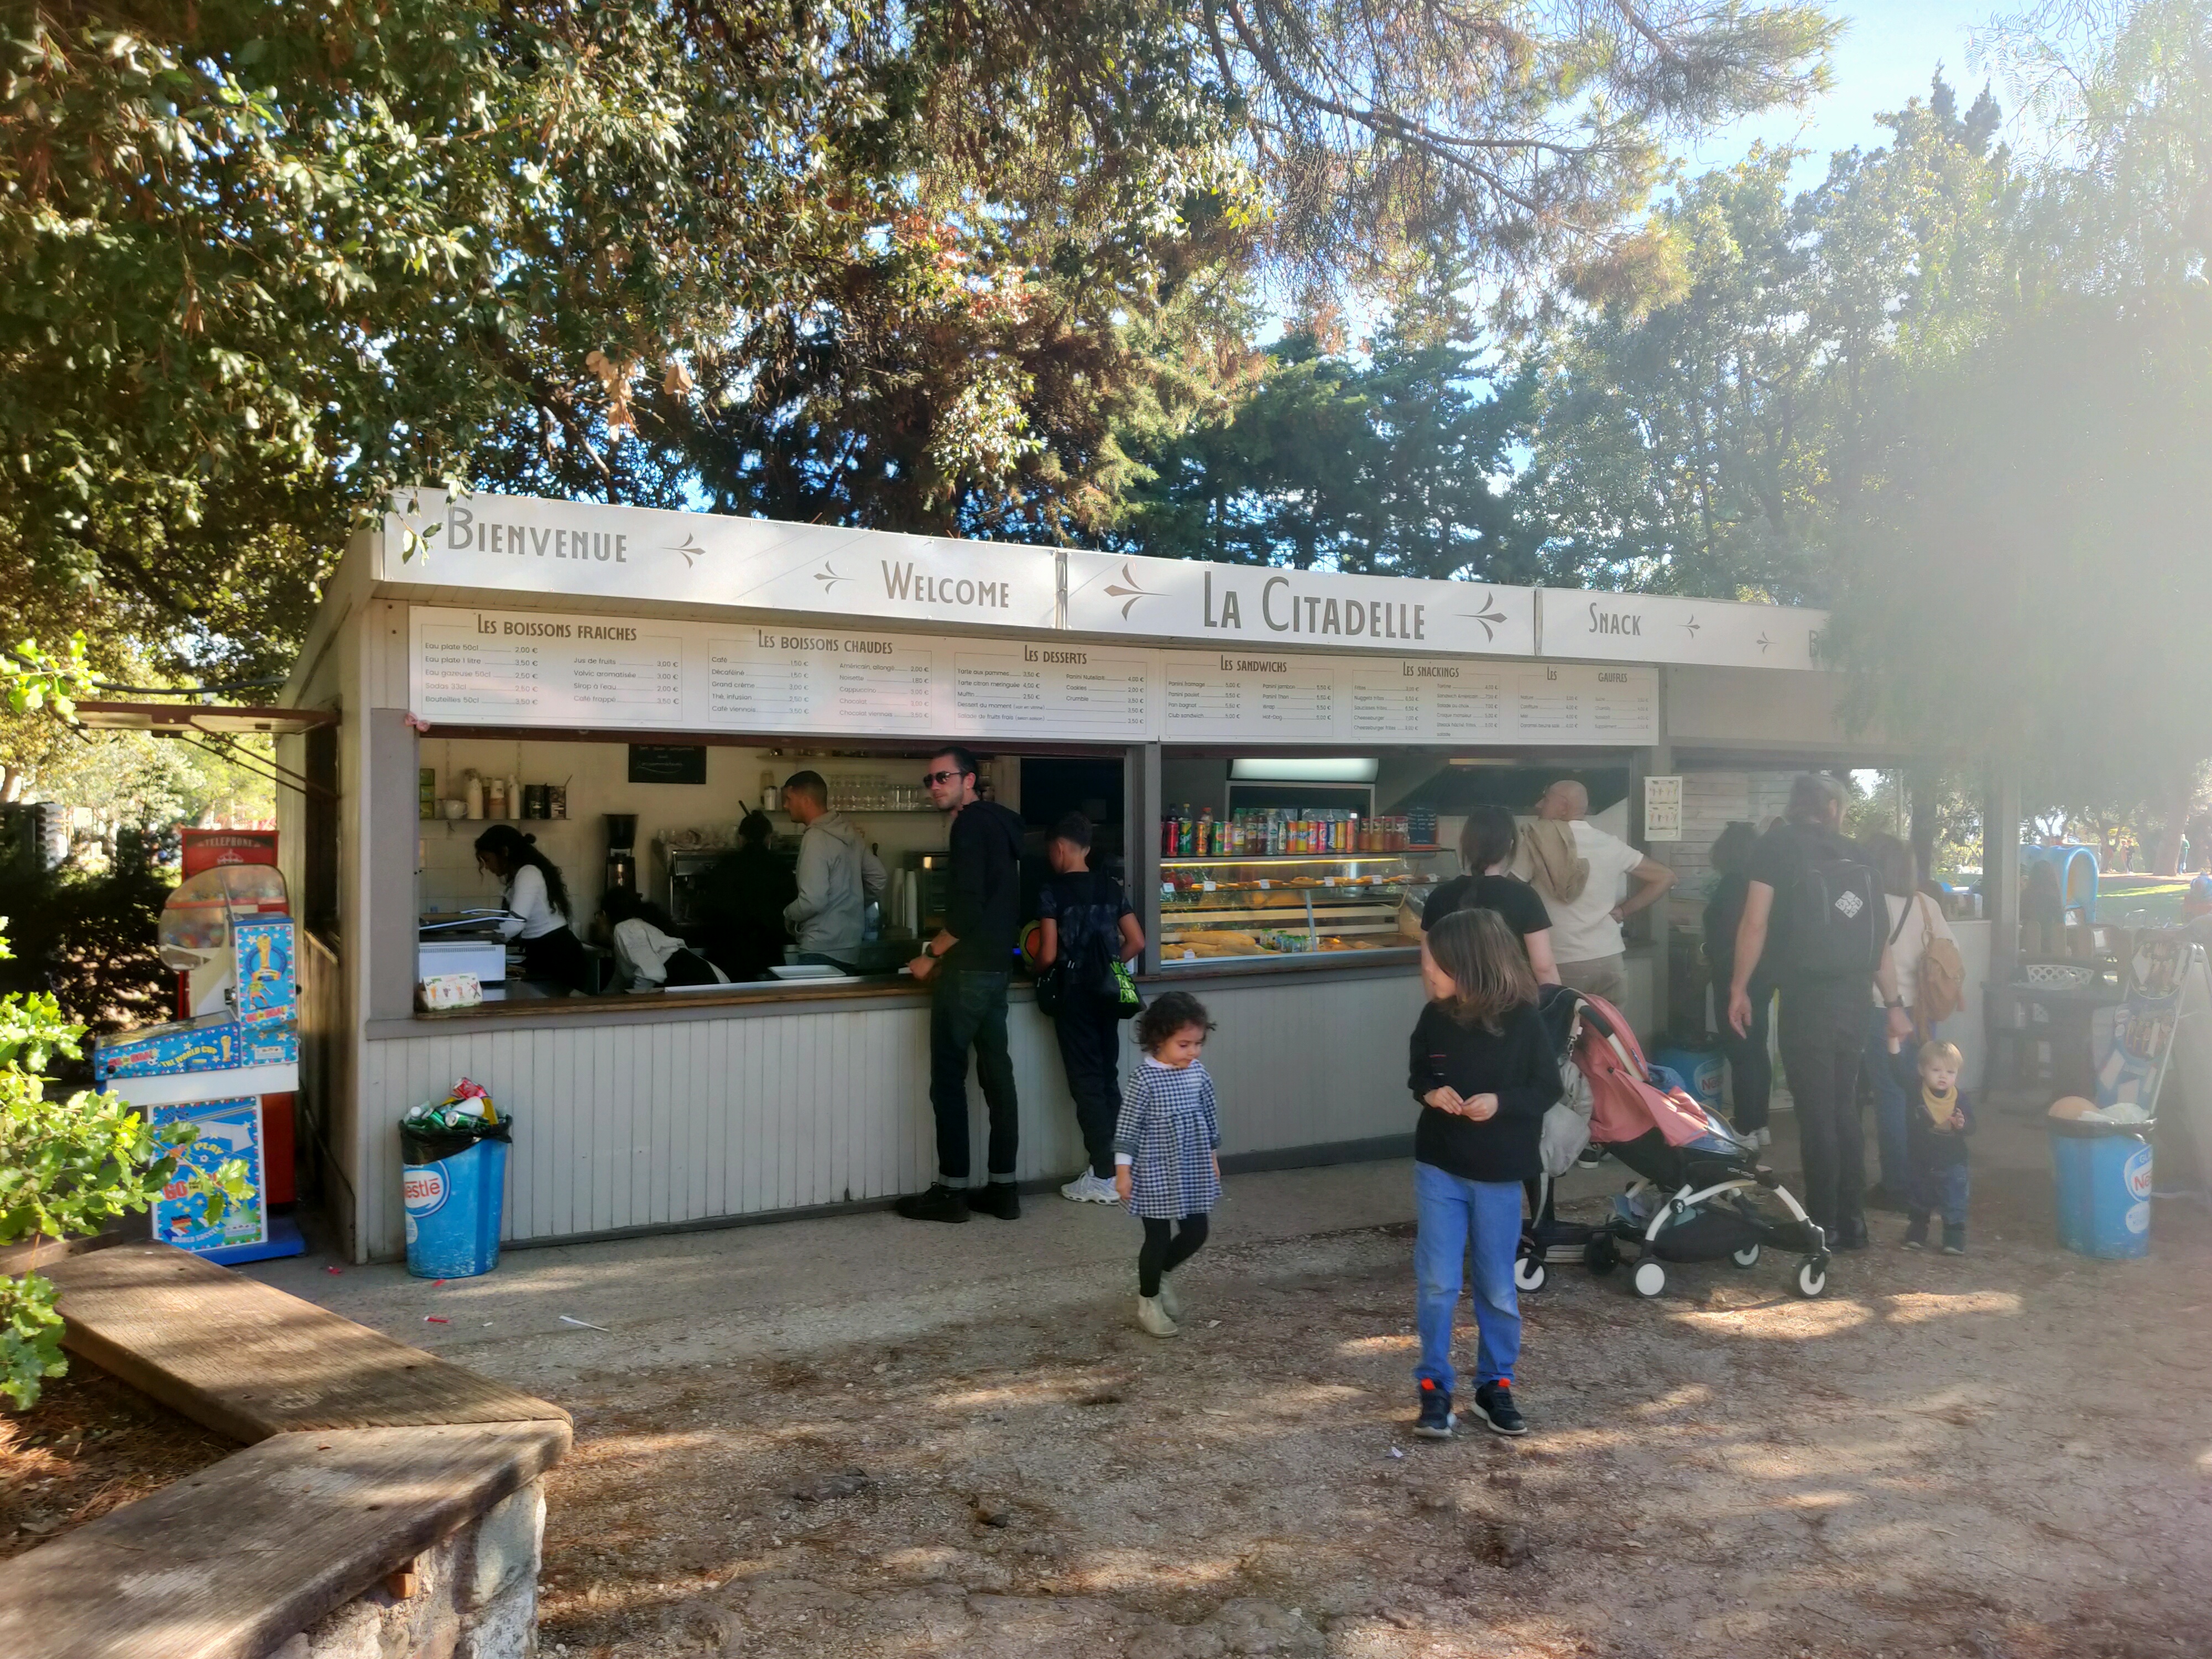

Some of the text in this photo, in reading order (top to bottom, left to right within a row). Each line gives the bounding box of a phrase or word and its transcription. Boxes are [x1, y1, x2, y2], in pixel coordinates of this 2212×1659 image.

[448, 507, 627, 562] BIENVENUE
[881, 560, 1009, 608] WELCOME
[1204, 571, 1425, 640] LA CITADELLE
[478, 614, 637, 641] LES BOISSONS FRAICHES
[1589, 603, 1641, 636] SNACK
[759, 630, 893, 654] LES BOISSONS CHAUDES
[1025, 645, 1087, 664] LES DESSERTS
[1221, 654, 1287, 672] LES SANDWICHS
[1403, 661, 1459, 678] LES SNACKINGS
[404, 1177, 441, 1199] estlé
